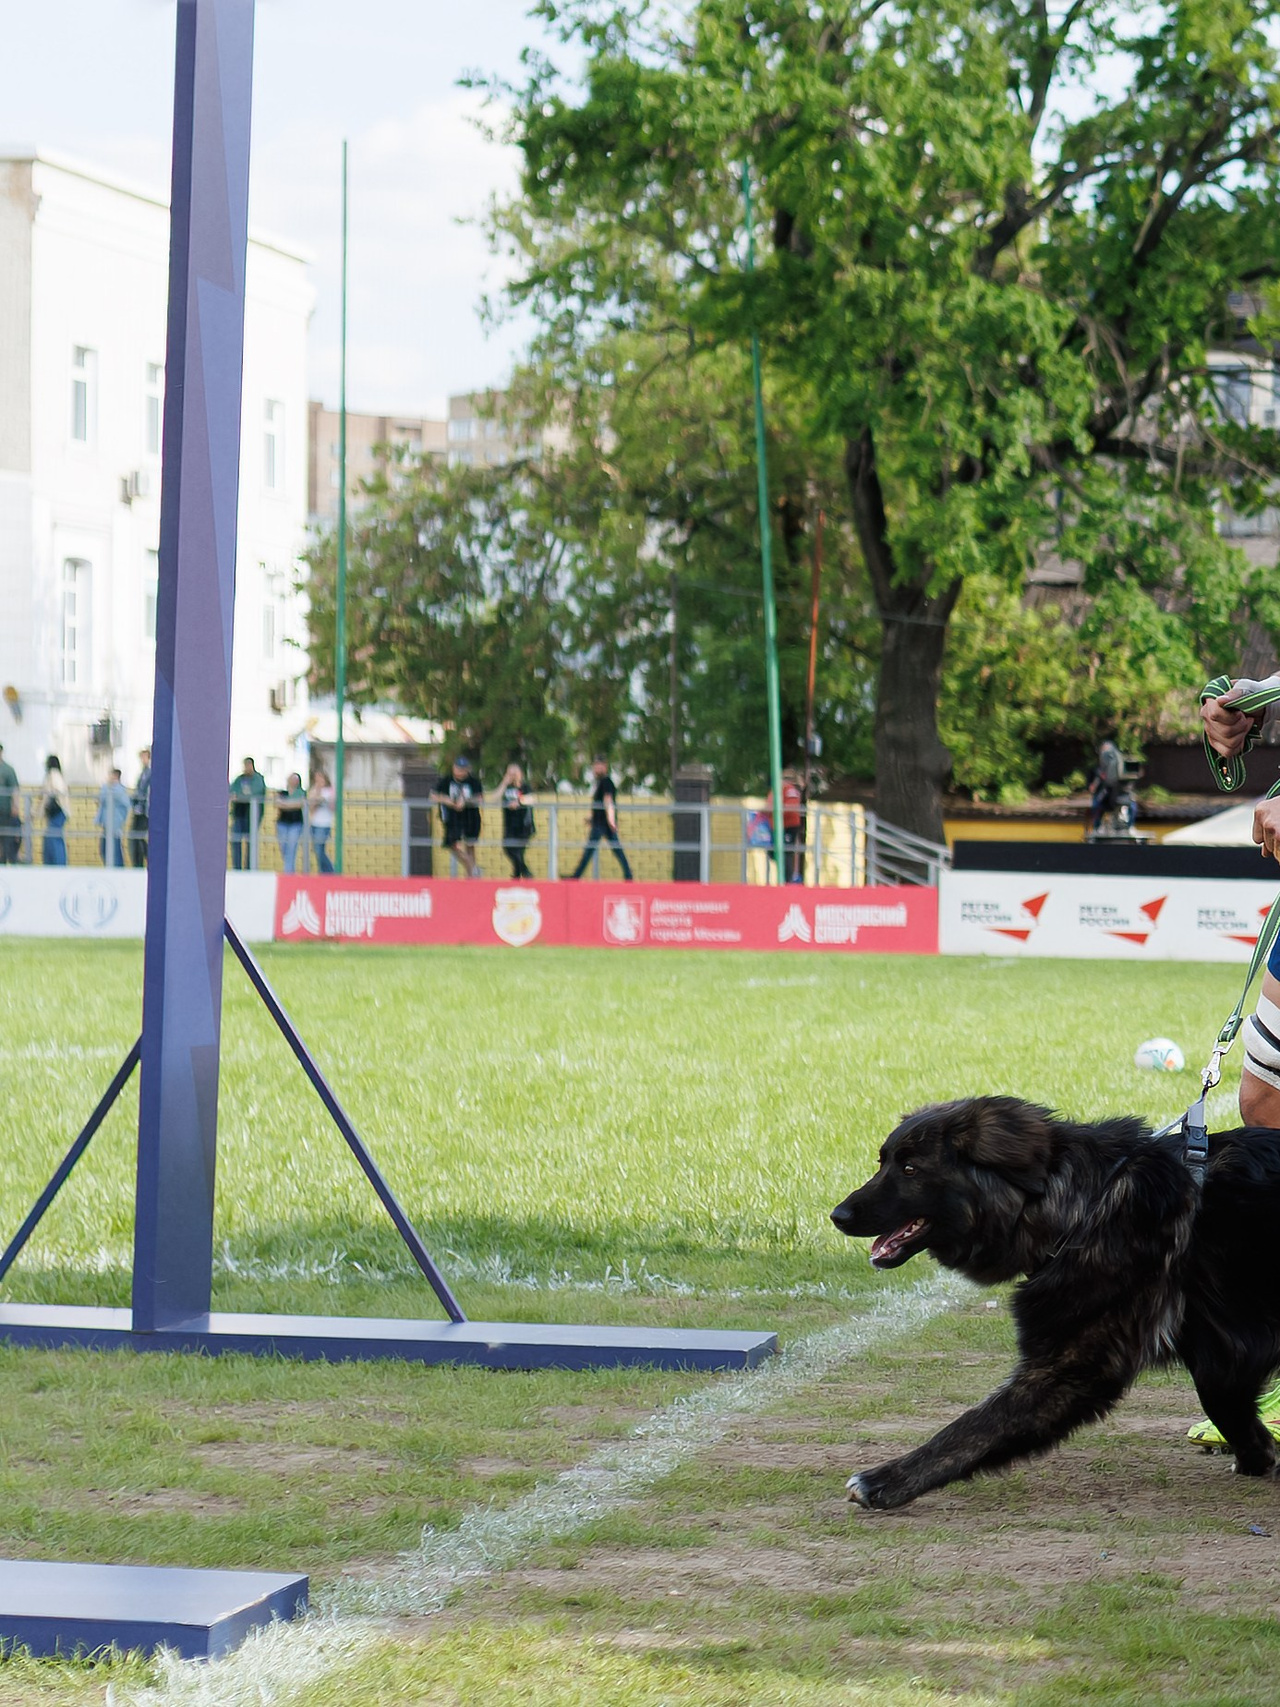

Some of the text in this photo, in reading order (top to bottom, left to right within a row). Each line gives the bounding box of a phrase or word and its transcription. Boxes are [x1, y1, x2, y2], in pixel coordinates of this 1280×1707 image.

[325, 888, 431, 917] МОСКОВСКИЙ
[815, 902, 907, 927] МОСКОВСКИЙ
[961, 913, 1012, 924] РОССИИ
[1079, 916, 1130, 927] РОССИИ
[325, 916, 376, 937] СПОРТ
[1197, 920, 1248, 930] РОССИИ
[814, 926, 859, 944] СПОРТ
